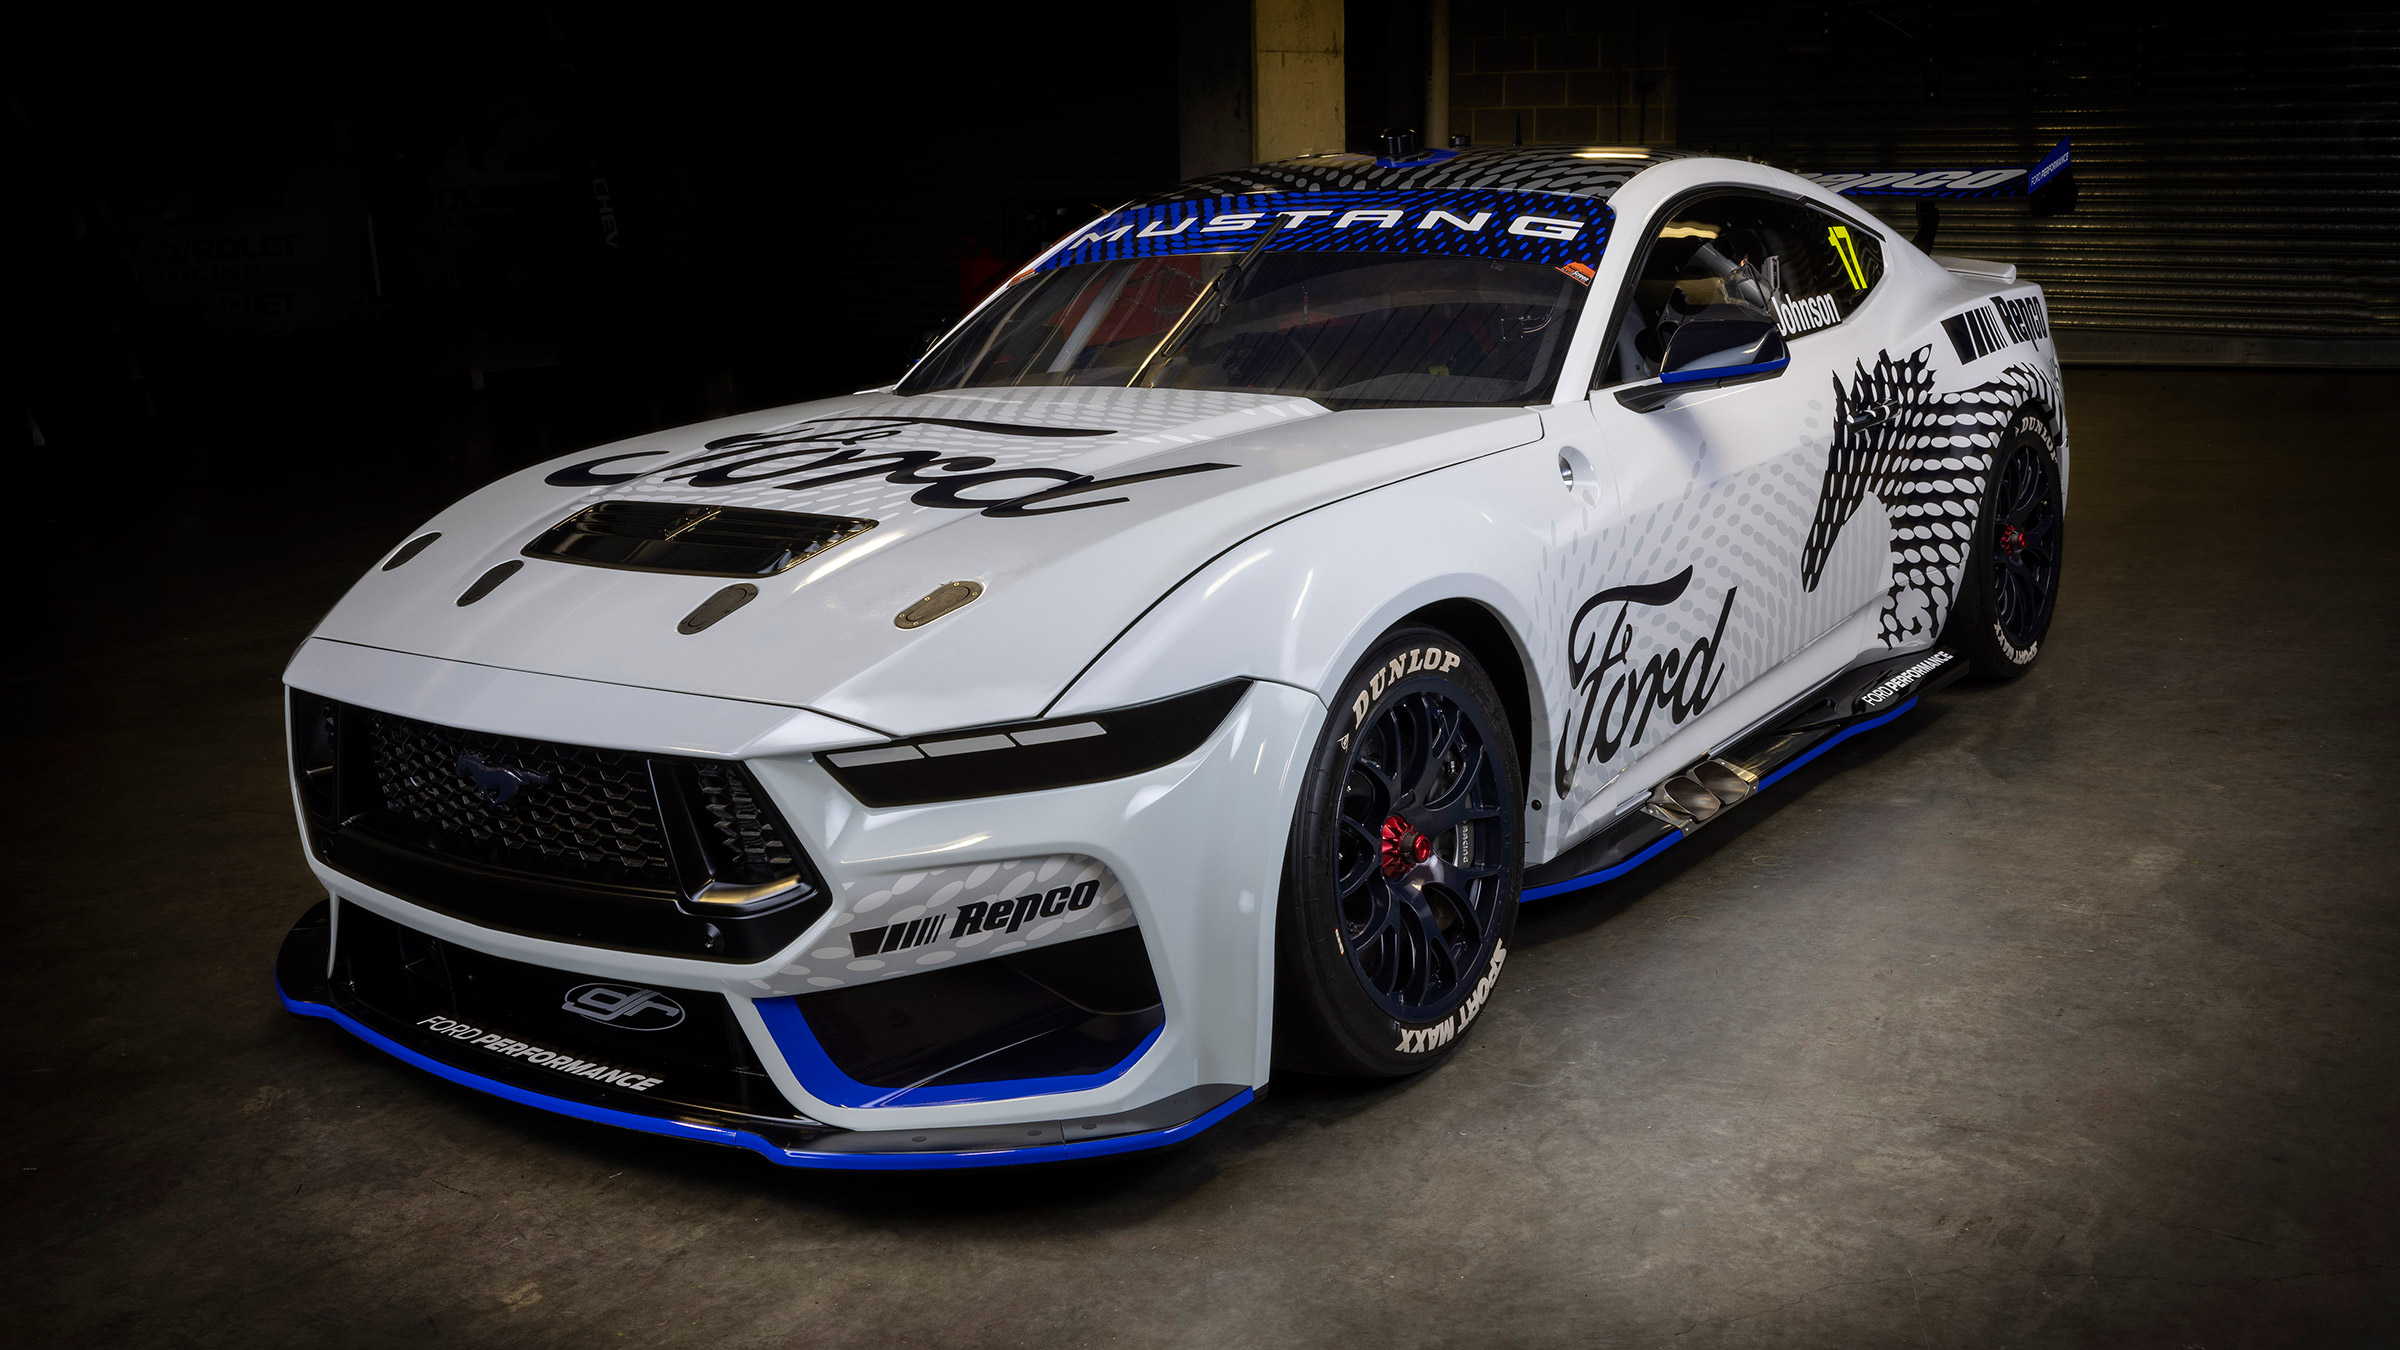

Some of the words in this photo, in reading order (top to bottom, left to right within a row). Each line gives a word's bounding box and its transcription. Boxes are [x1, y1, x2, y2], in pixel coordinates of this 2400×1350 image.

[1068, 210, 1585, 250] MUSTANG
[1827, 225, 1868, 290] 17
[1771, 293, 1841, 337] Johnson
[1989, 296, 2047, 352] Repco
[545, 415, 1242, 518] Ford
[2020, 416, 2058, 464] DUNLOP
[1352, 647, 1460, 730] DUNLOP
[1555, 564, 1738, 800] Ford
[1861, 685, 1894, 707] FORD
[1884, 650, 1954, 692] PERFORMANCE
[949, 879, 1100, 939] Repco
[1457, 937, 1507, 1034] SPORT
[416, 1015, 483, 1041] FORD
[478, 1033, 665, 1092] PERFORMANCE
[1395, 1015, 1455, 1054] MAXX
